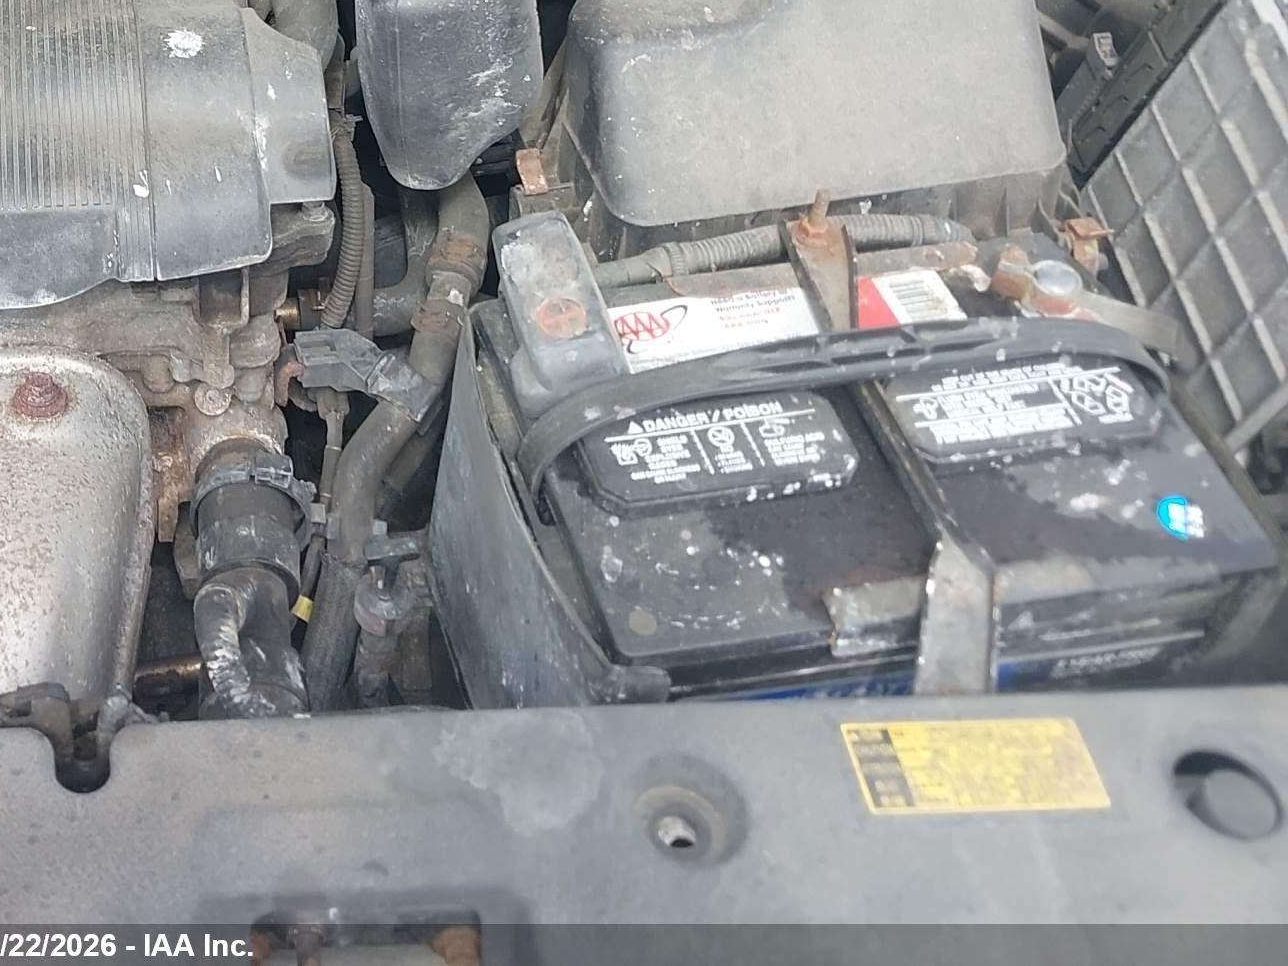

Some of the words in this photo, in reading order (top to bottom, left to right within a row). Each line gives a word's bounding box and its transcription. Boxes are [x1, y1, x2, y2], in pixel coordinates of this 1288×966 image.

[612, 313, 668, 342] AAA
[642, 411, 710, 433] DANGER
[722, 401, 784, 422] POISON
